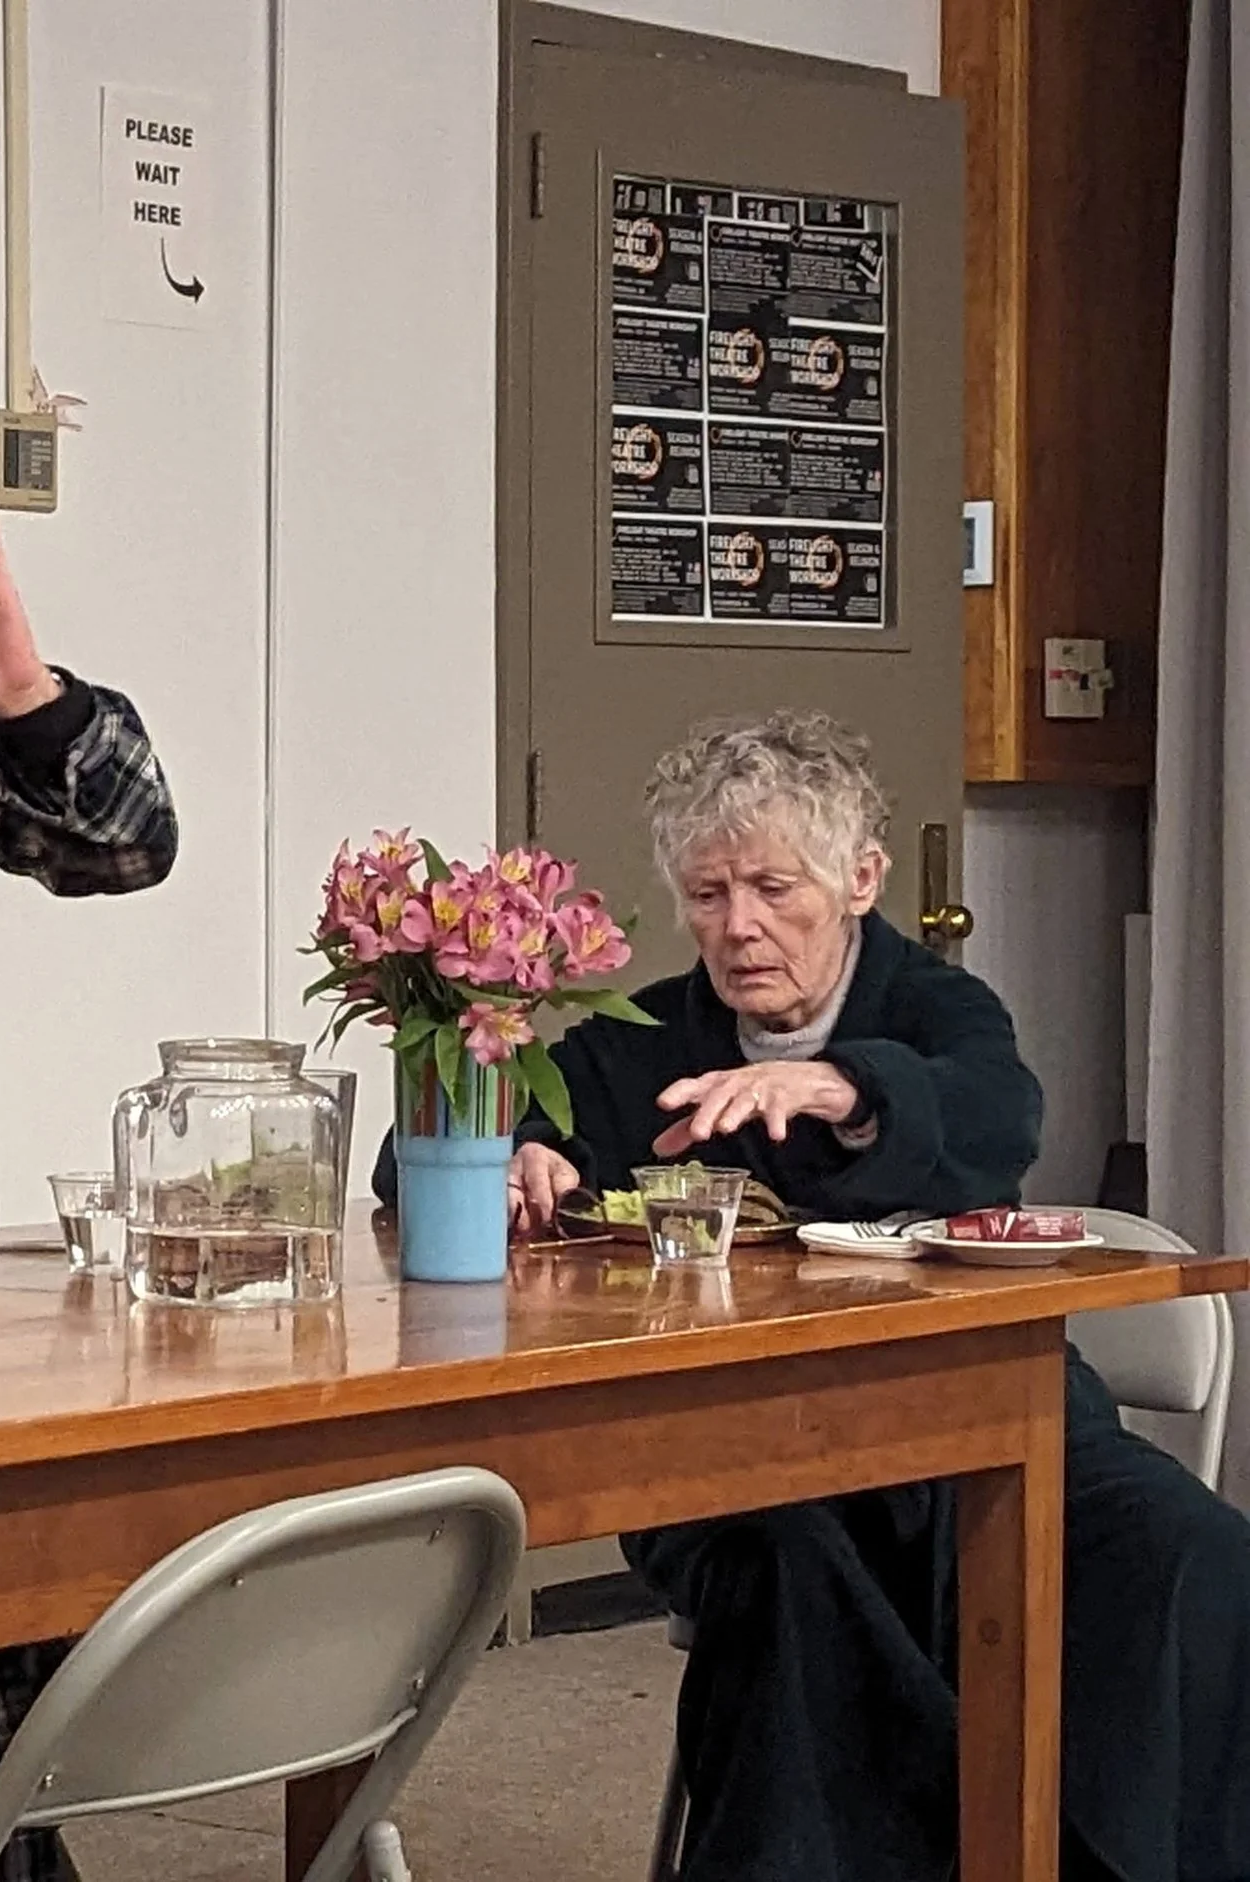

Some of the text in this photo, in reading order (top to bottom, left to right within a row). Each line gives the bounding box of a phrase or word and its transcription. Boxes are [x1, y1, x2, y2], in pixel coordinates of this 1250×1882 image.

[125, 118, 194, 148] PLEASE
[135, 160, 181, 186] WAIT
[134, 201, 181, 227] HERE
